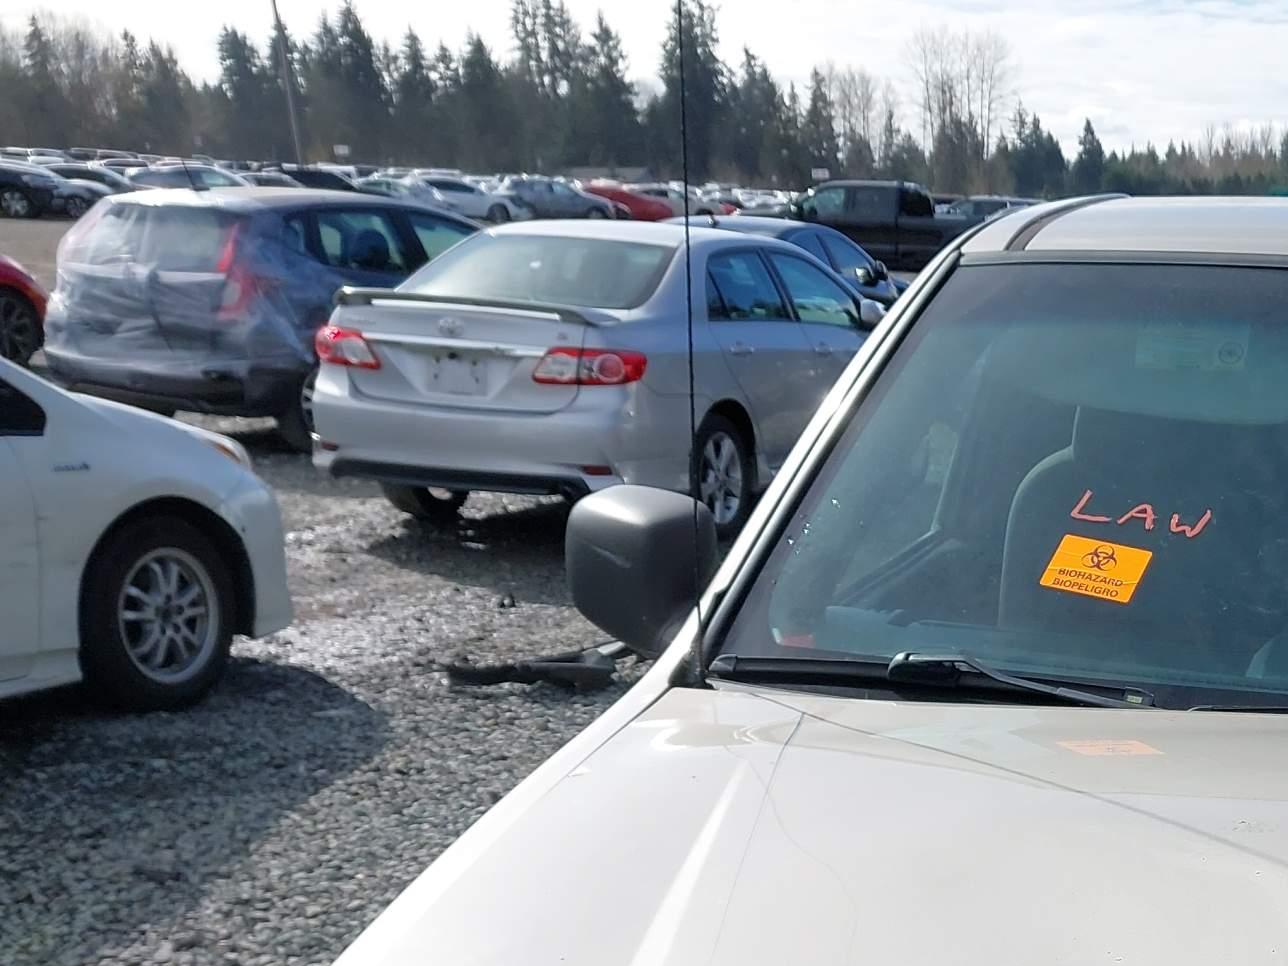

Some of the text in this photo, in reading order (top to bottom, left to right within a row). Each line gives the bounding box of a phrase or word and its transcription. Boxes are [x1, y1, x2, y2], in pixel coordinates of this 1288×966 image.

[1070, 489, 1213, 538] LAW
[1051, 577, 1119, 598] BIOPELIGRO
[1057, 567, 1124, 587] BIOHAZARD
